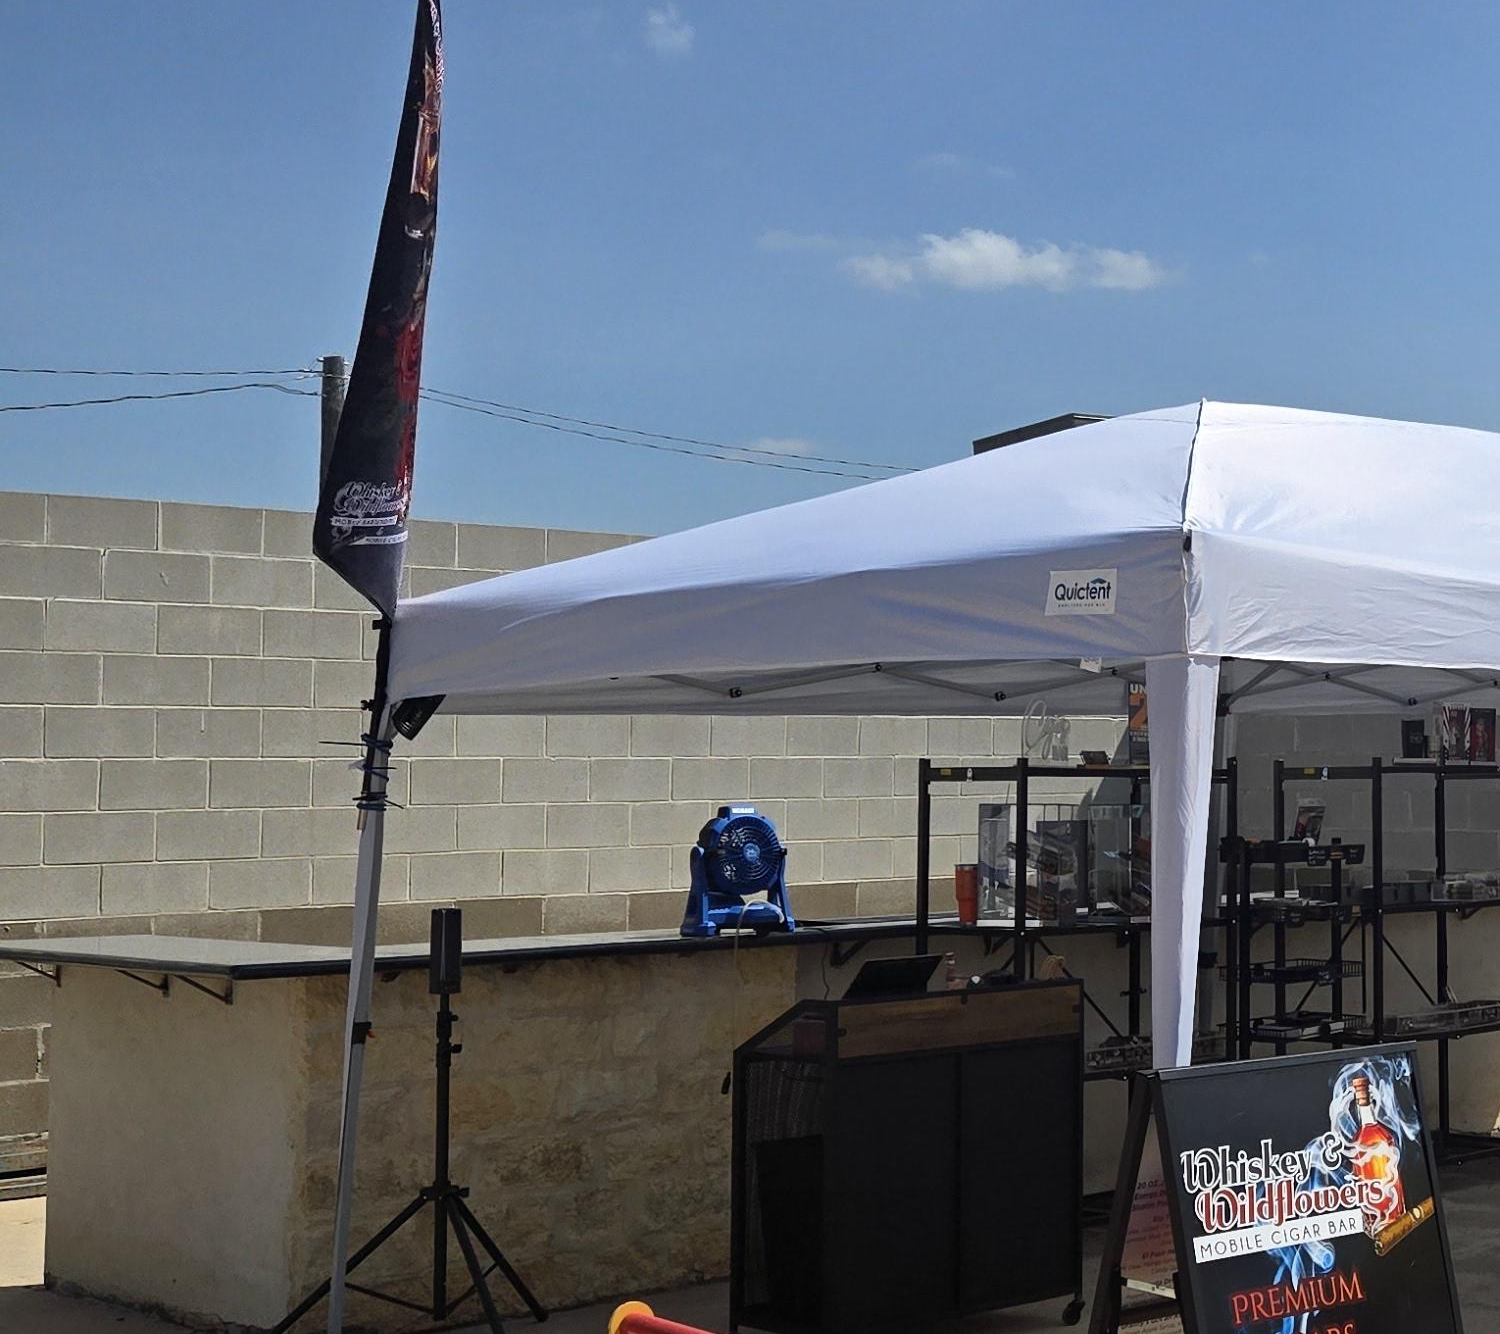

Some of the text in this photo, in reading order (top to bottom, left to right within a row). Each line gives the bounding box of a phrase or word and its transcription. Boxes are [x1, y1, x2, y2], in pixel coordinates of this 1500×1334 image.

[1054, 581, 1112, 601] Quictent
[1180, 1131, 1344, 1194] Whiskey &
[1195, 1178, 1385, 1234] Wildflowers
[1200, 1217, 1357, 1258] MOBILE CIGAR BAR
[1231, 1271, 1365, 1325] PREMIUM
